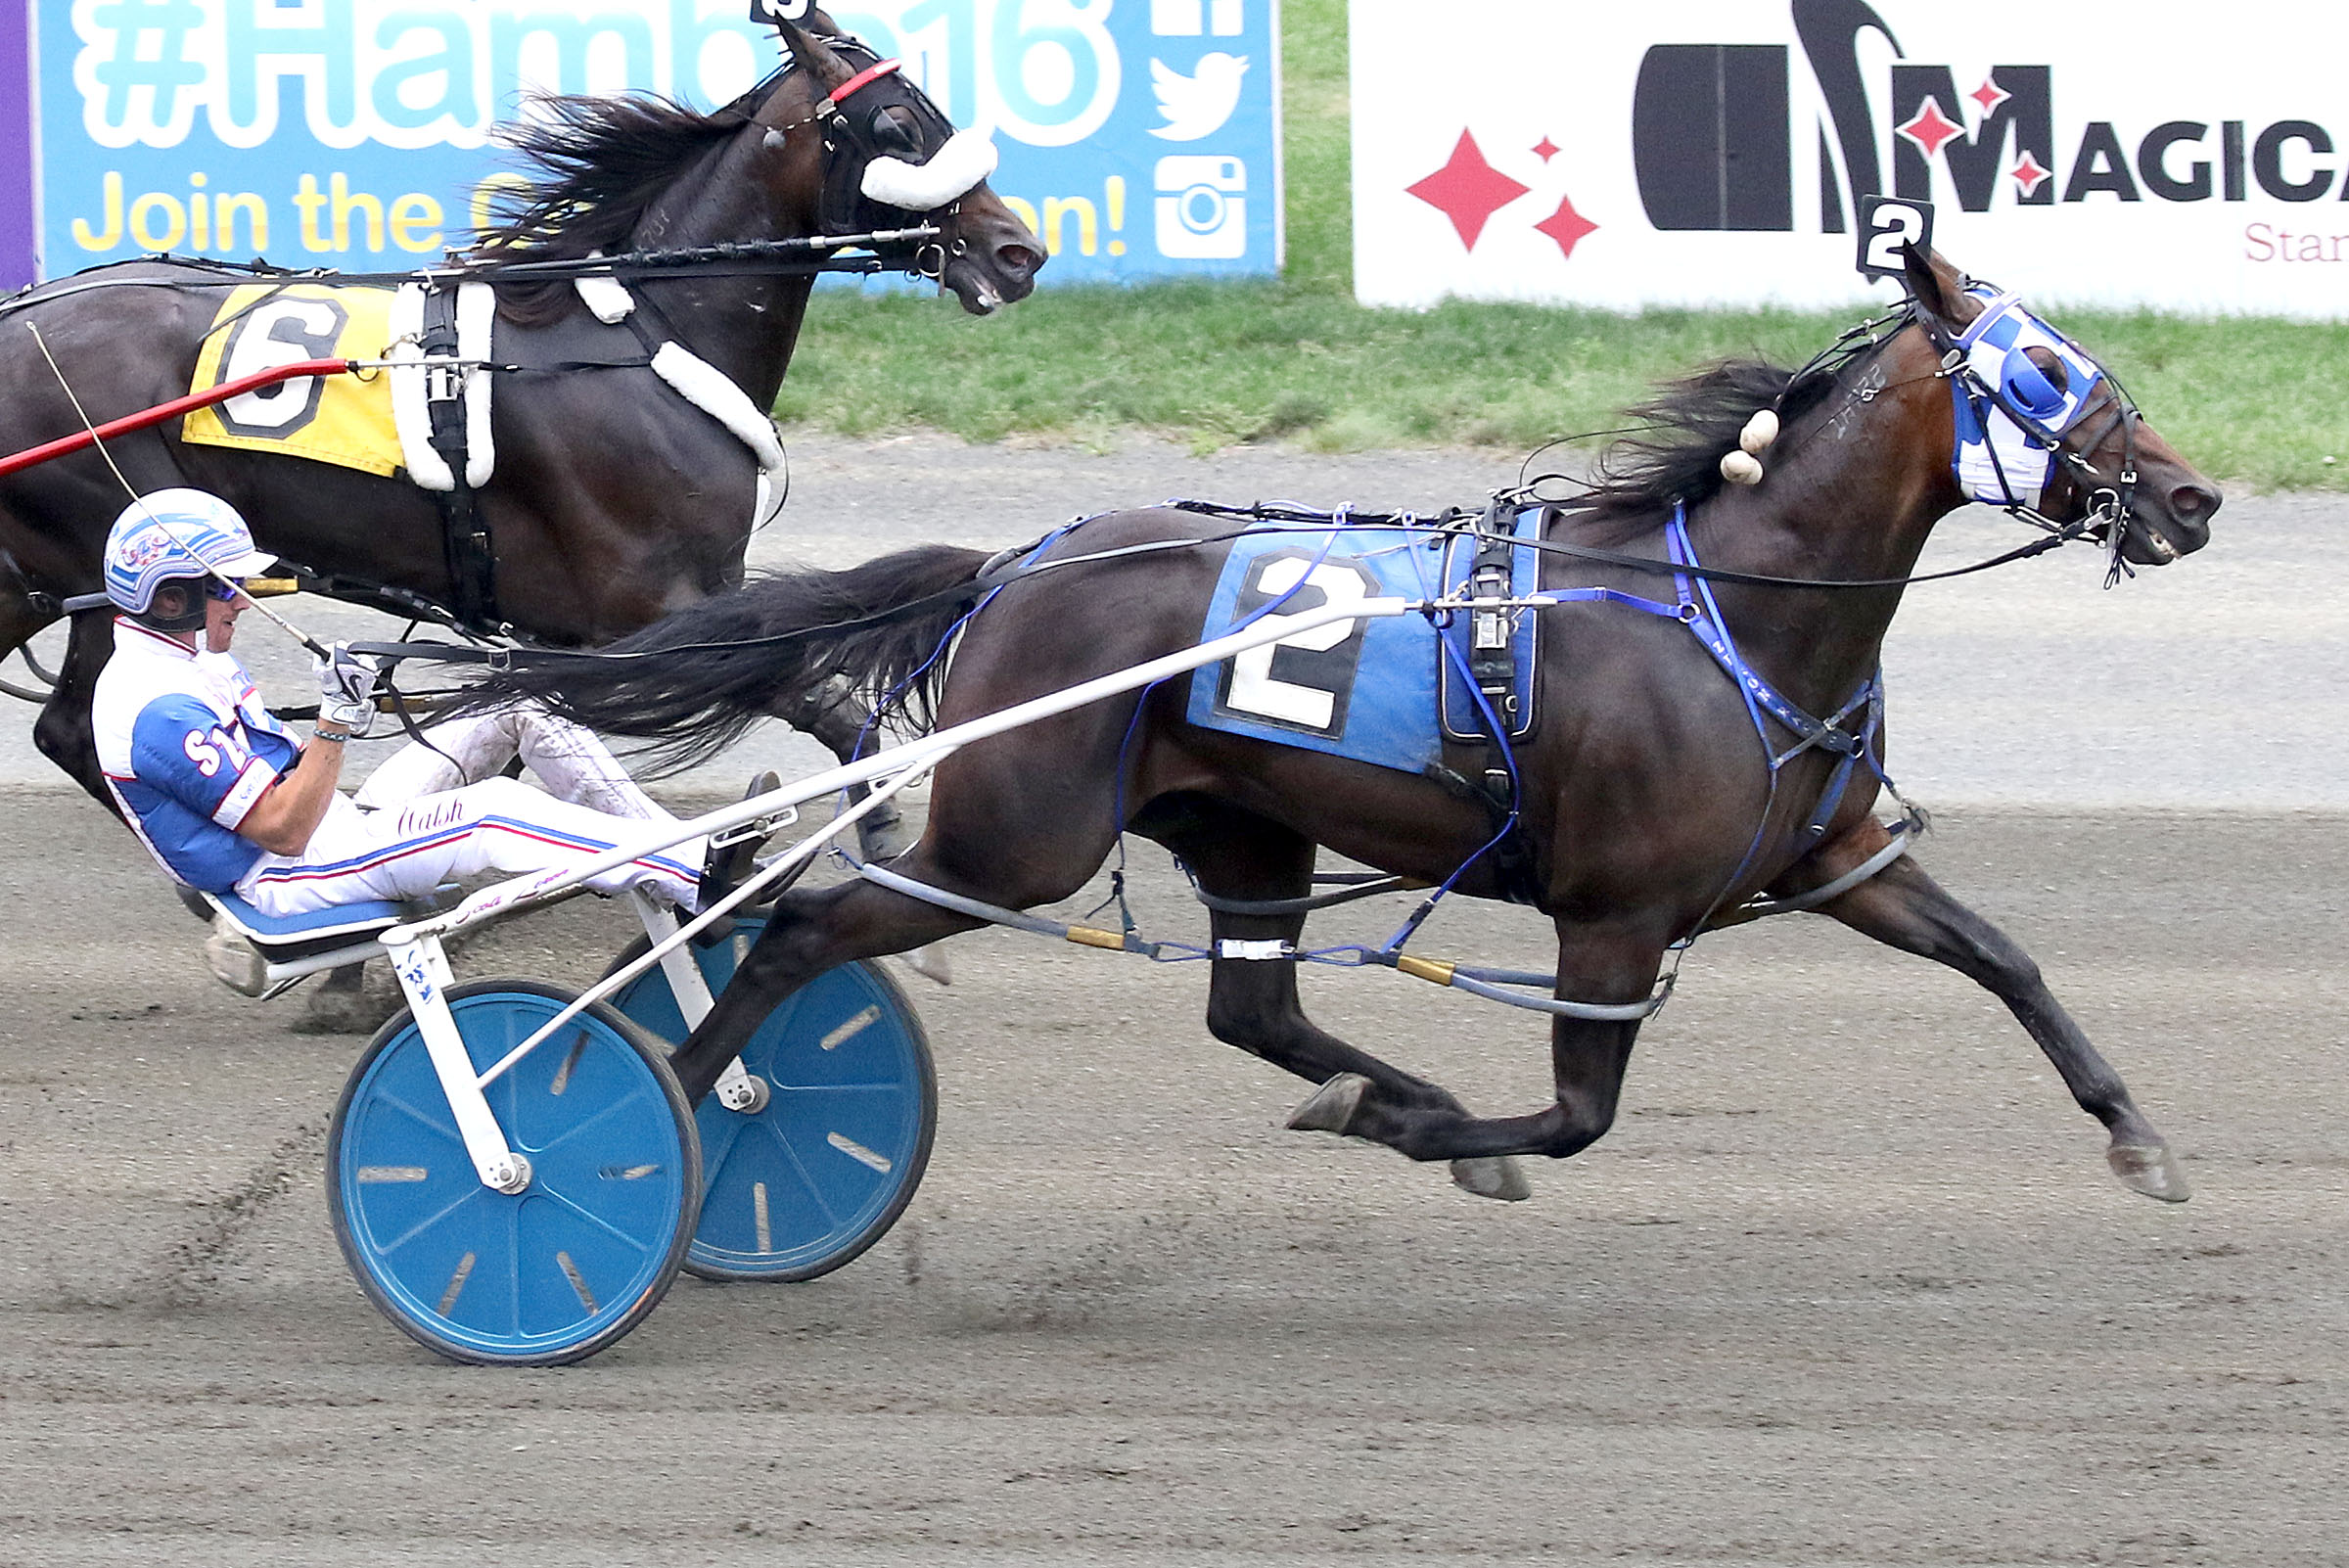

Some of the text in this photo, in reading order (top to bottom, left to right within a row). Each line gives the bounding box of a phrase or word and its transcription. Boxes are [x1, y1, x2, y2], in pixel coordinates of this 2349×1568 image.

[1891, 65, 2349, 212] MAGIC
[72, 171, 268, 253] Join
[293, 171, 444, 253] the
[1865, 203, 1925, 271] 2
[224, 299, 339, 428] 6
[1226, 556, 1368, 730] 2
